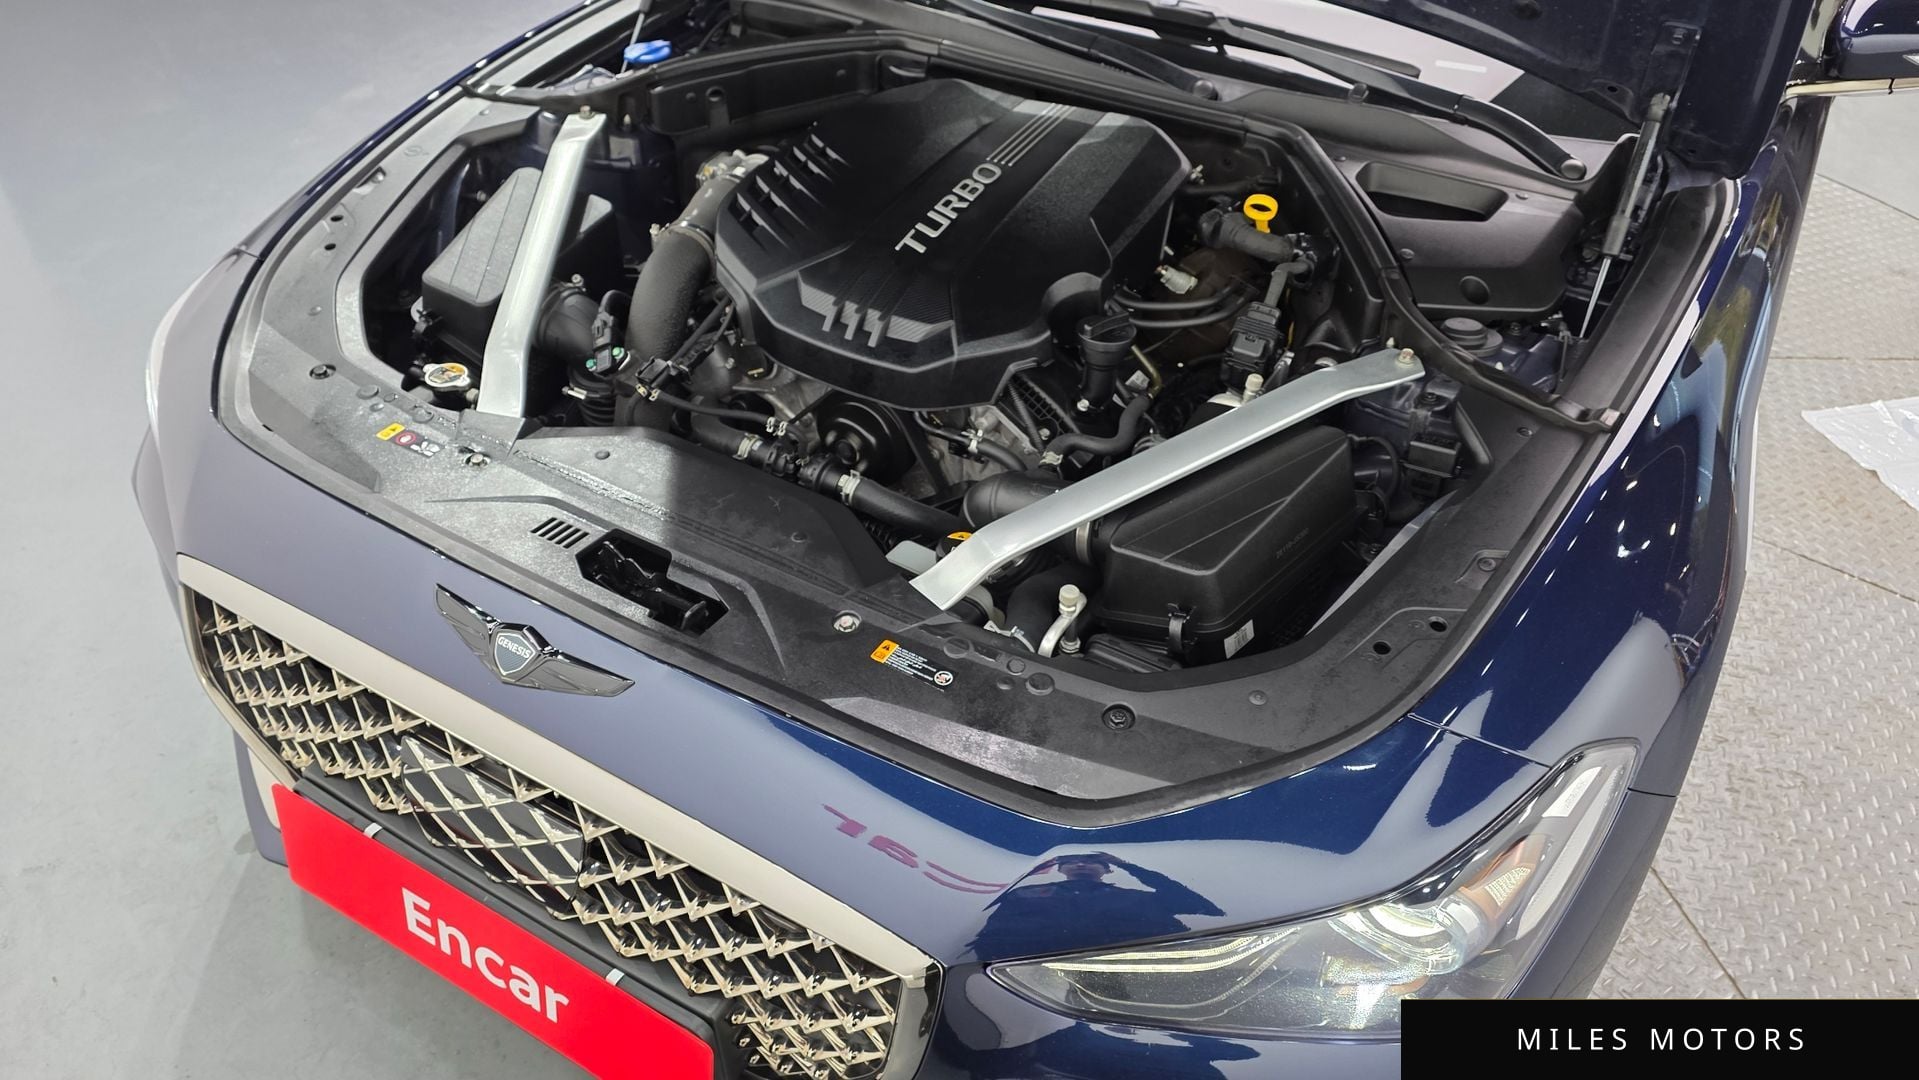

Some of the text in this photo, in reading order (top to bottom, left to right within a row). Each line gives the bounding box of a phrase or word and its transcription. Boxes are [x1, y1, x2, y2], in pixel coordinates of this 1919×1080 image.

[895, 163, 1002, 254] TURBO
[497, 636, 532, 659] GENESIS
[402, 887, 570, 1023] Encar
